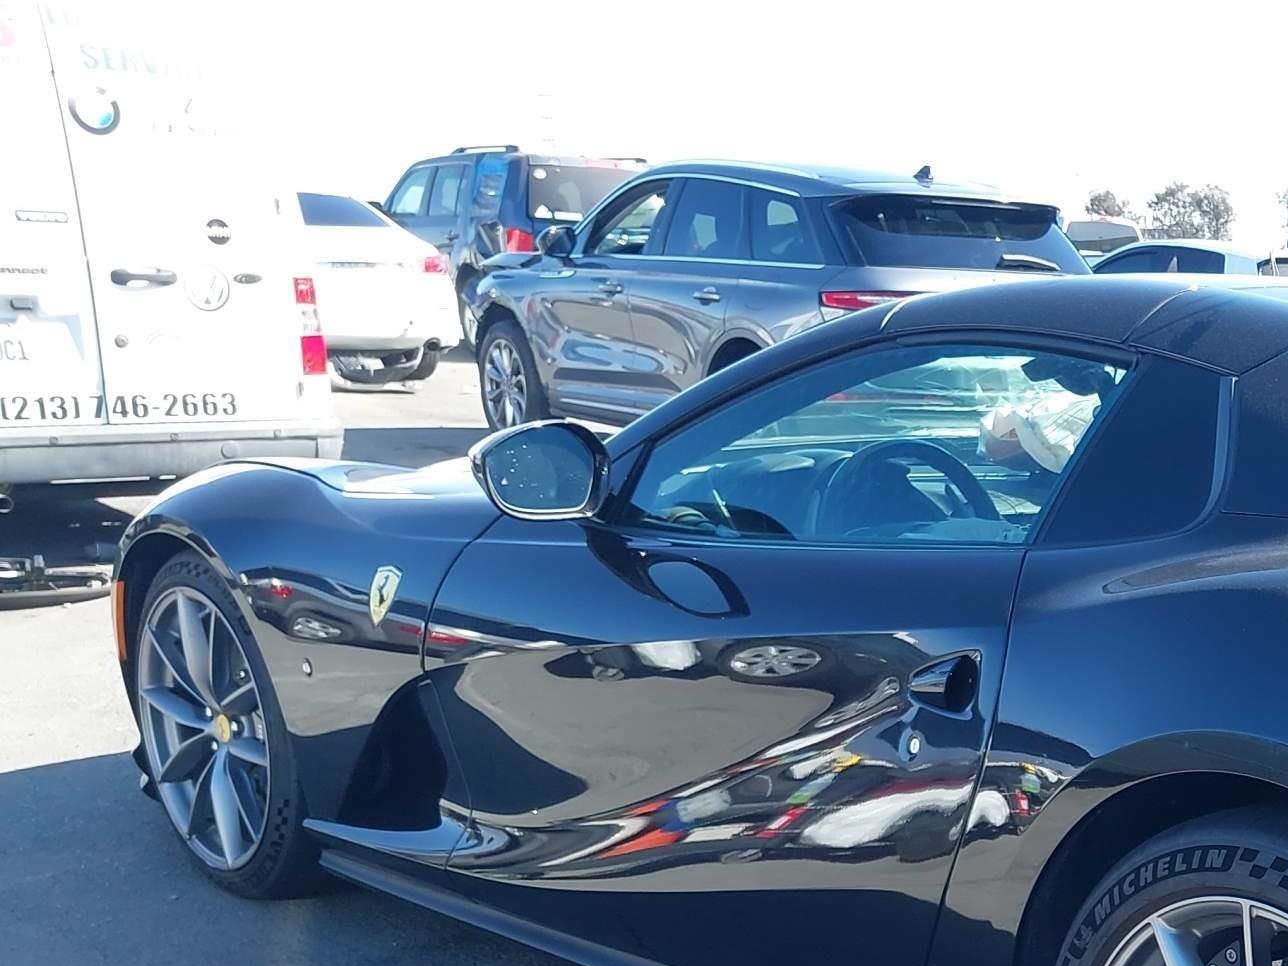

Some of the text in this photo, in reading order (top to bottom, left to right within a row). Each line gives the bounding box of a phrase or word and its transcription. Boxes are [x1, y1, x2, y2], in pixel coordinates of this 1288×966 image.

[0, 339, 30, 361] C1
[0, 393, 238, 420] (213) 746-2663
[1093, 847, 1228, 926] MICHELIN
